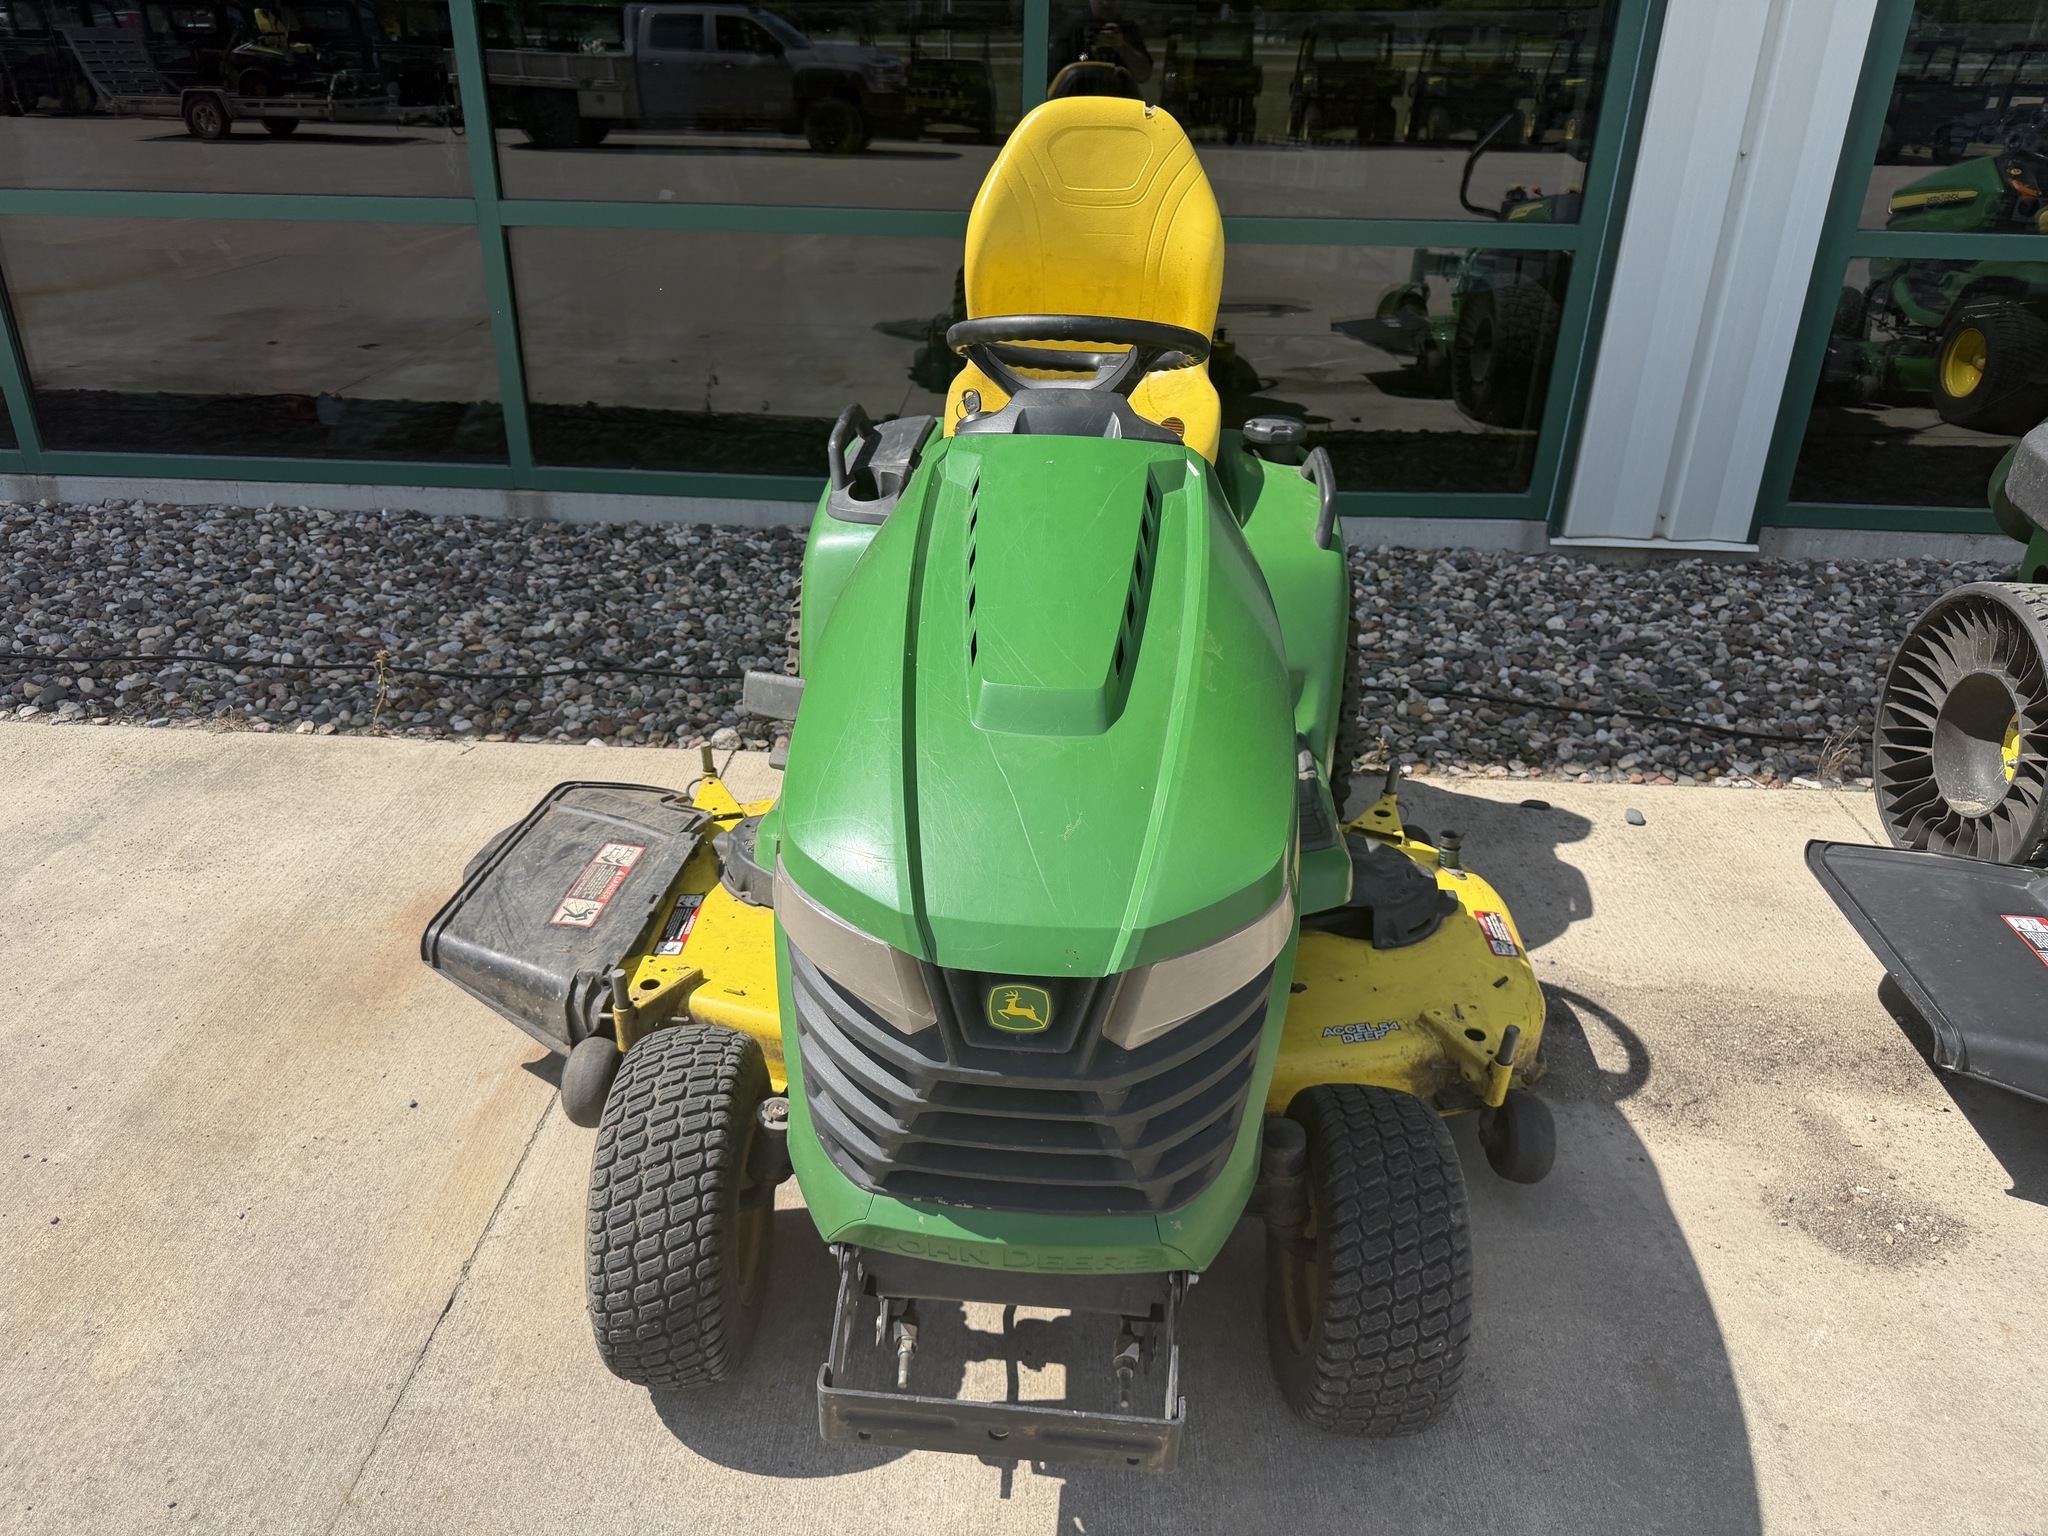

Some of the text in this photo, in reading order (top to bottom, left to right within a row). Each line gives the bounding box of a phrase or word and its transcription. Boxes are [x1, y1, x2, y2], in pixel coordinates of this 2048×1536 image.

[1322, 1021, 1400, 1037] ACCEL 54
[1342, 1031, 1386, 1044] DEEP
[874, 1236, 1153, 1271] JOHN DEERE
